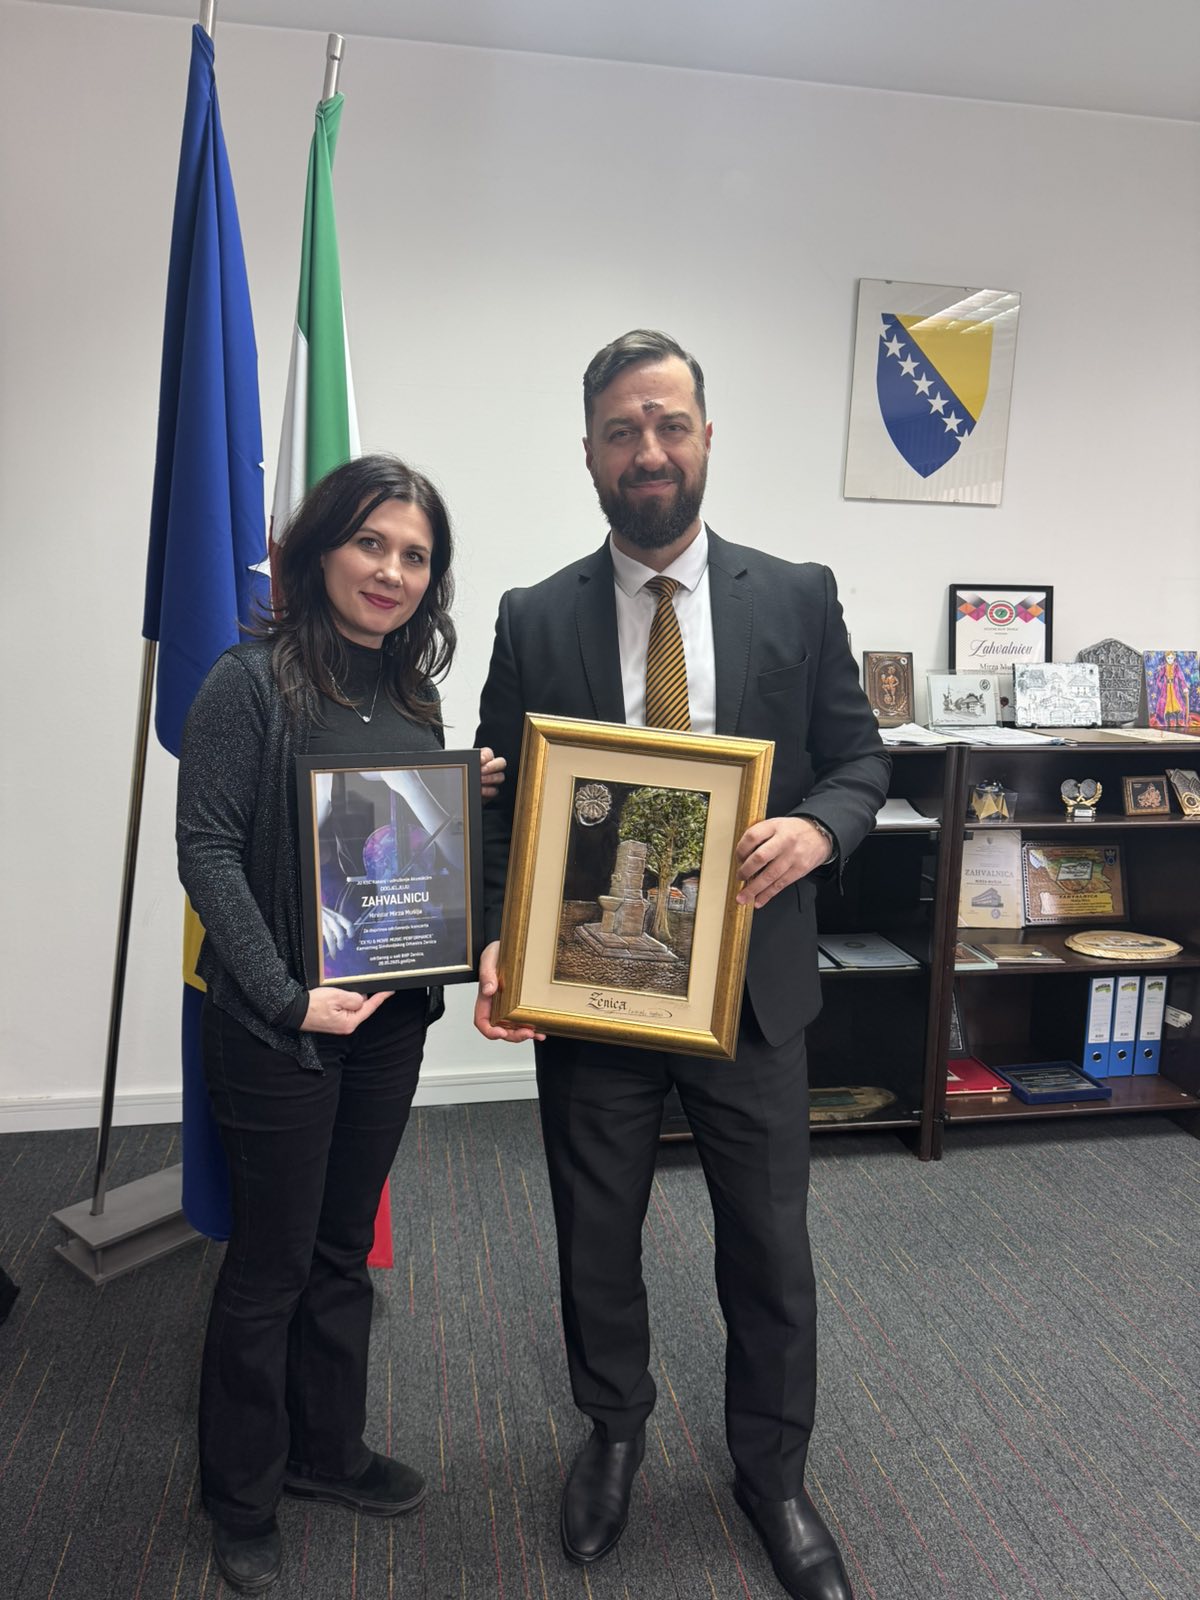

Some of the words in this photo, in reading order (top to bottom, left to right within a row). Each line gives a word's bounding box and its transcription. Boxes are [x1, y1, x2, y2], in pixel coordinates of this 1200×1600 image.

[965, 869, 1015, 878] ZAHVALNICA
[361, 892, 430, 907] ZAHVALNICU
[587, 991, 628, 1011] Zenica
